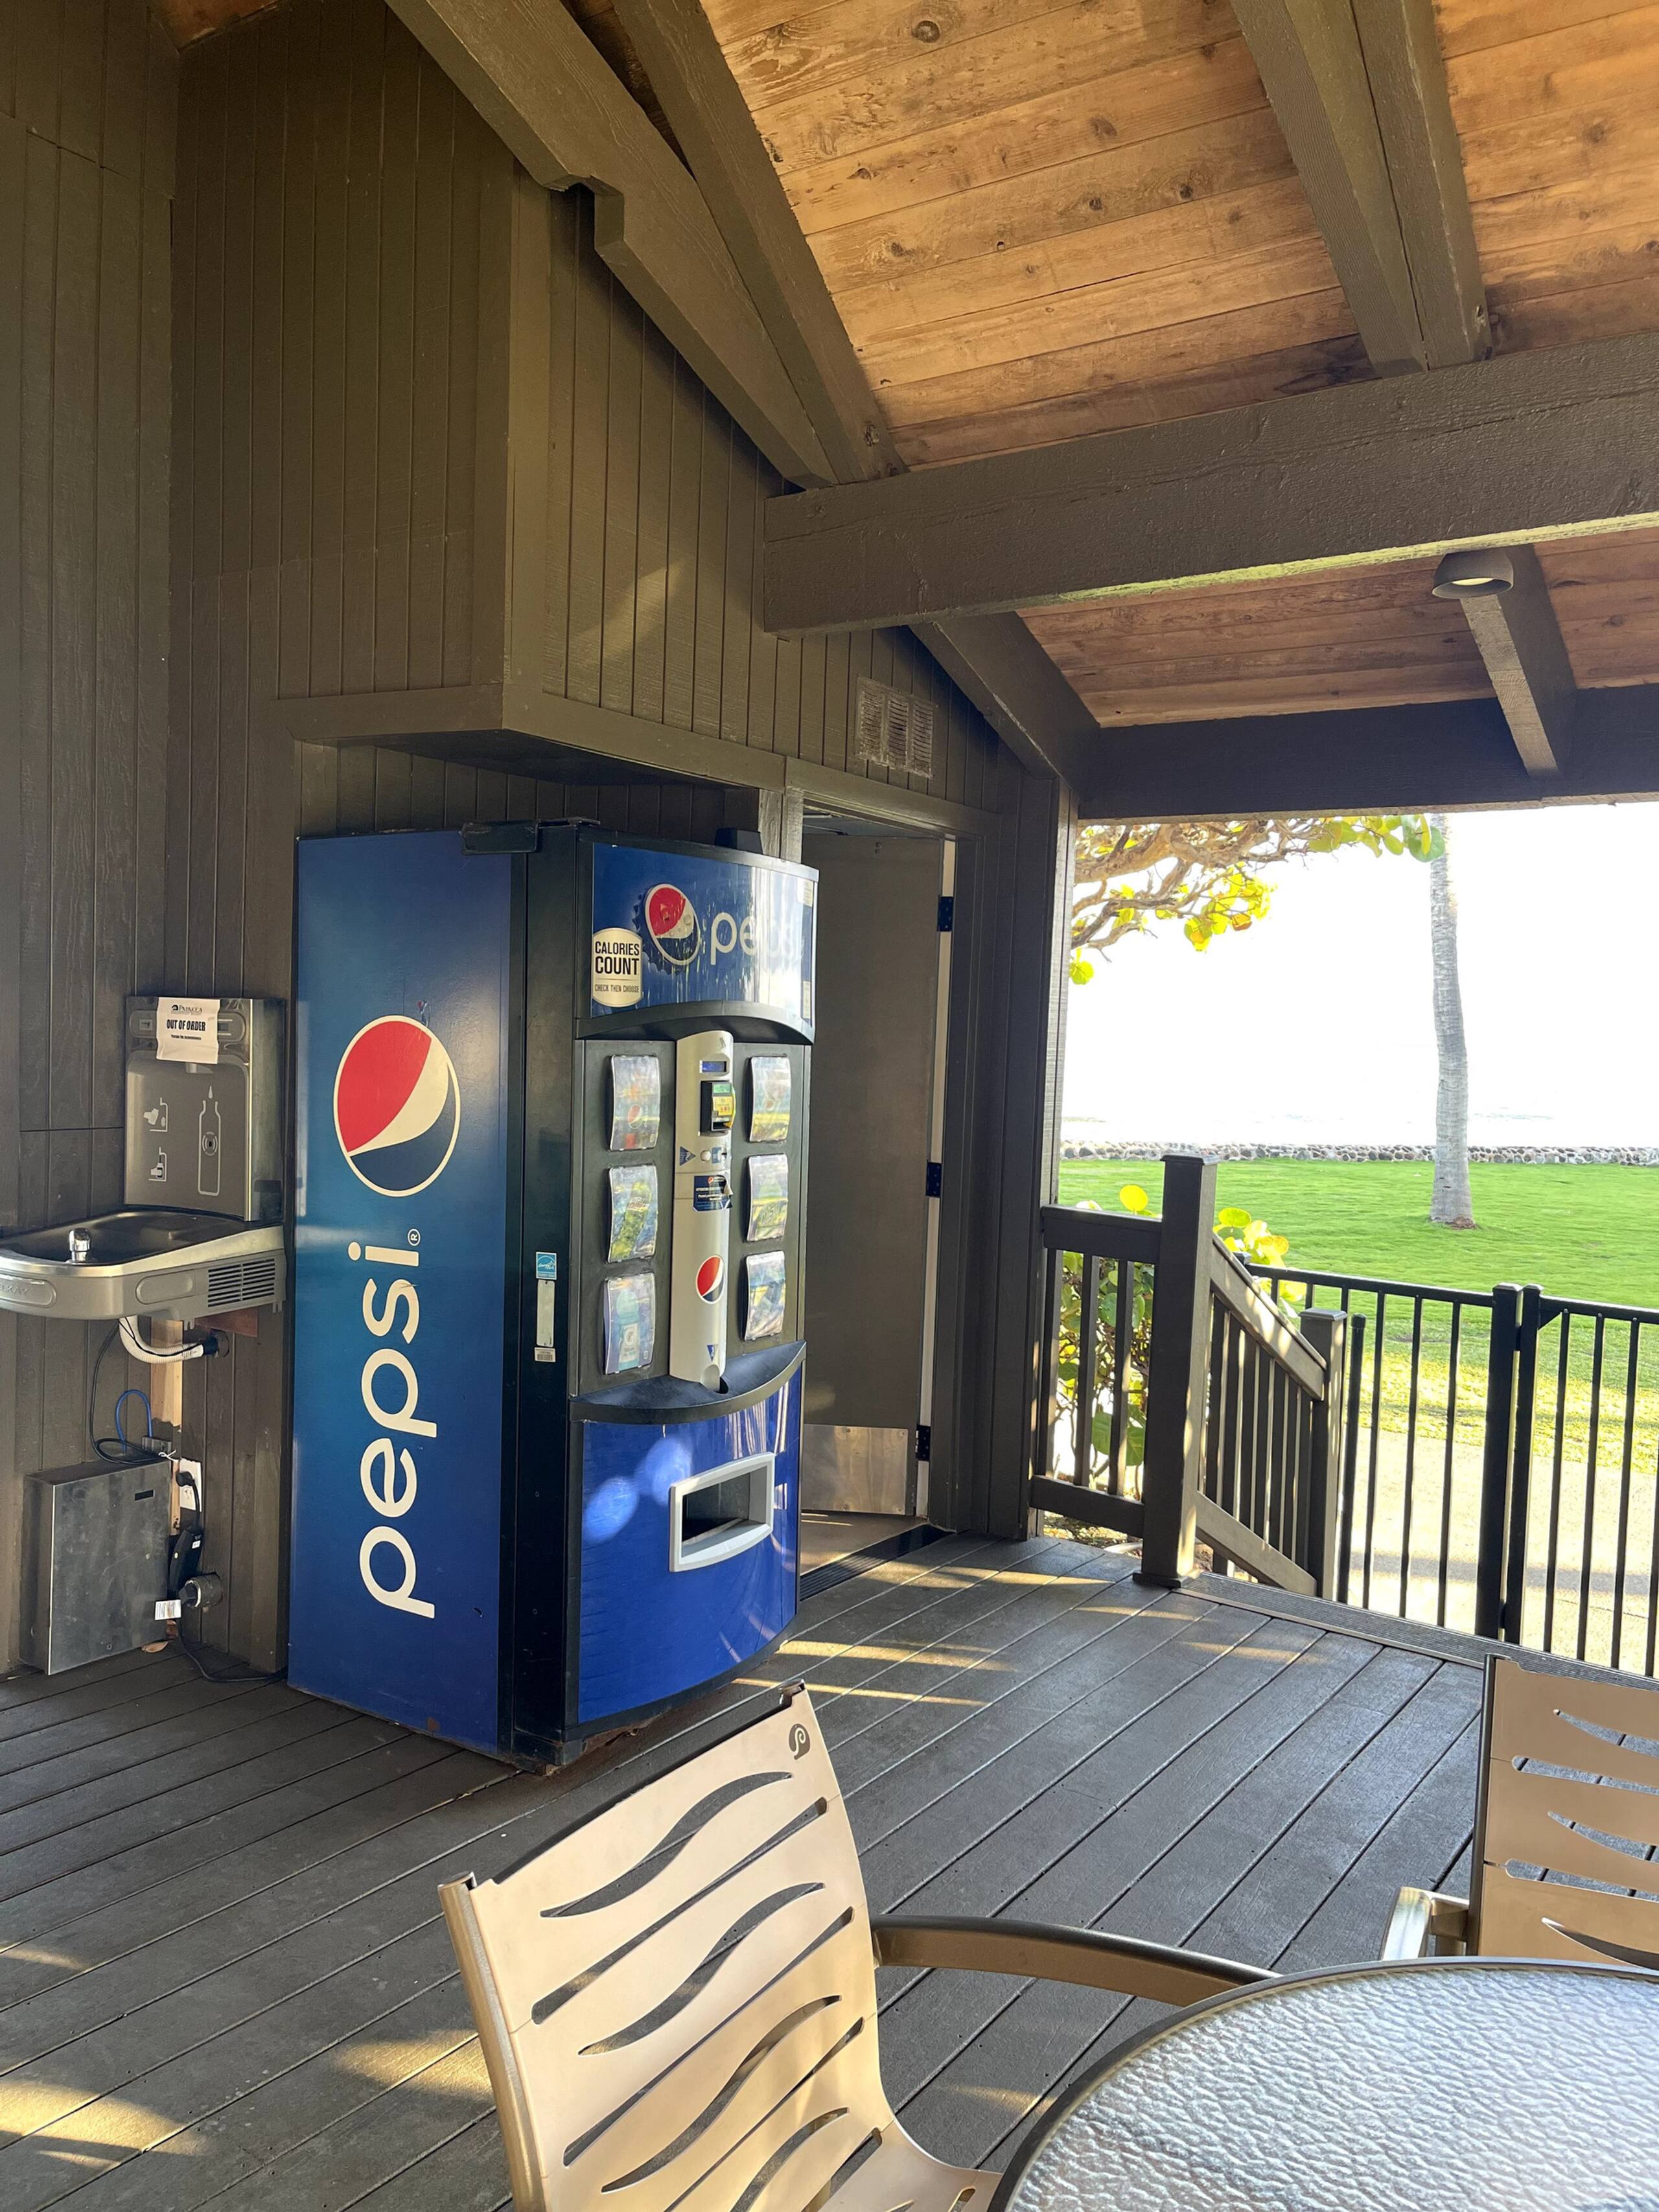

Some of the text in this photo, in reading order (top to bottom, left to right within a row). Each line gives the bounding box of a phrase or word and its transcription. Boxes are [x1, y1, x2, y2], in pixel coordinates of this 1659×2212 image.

[595, 941, 640, 956] CALORIES
[595, 956, 640, 975] COUNT
[595, 984, 609, 992] CHECK
[623, 985, 640, 994] CHOOSE
[167, 1019, 206, 1032] OUT OF ORDER
